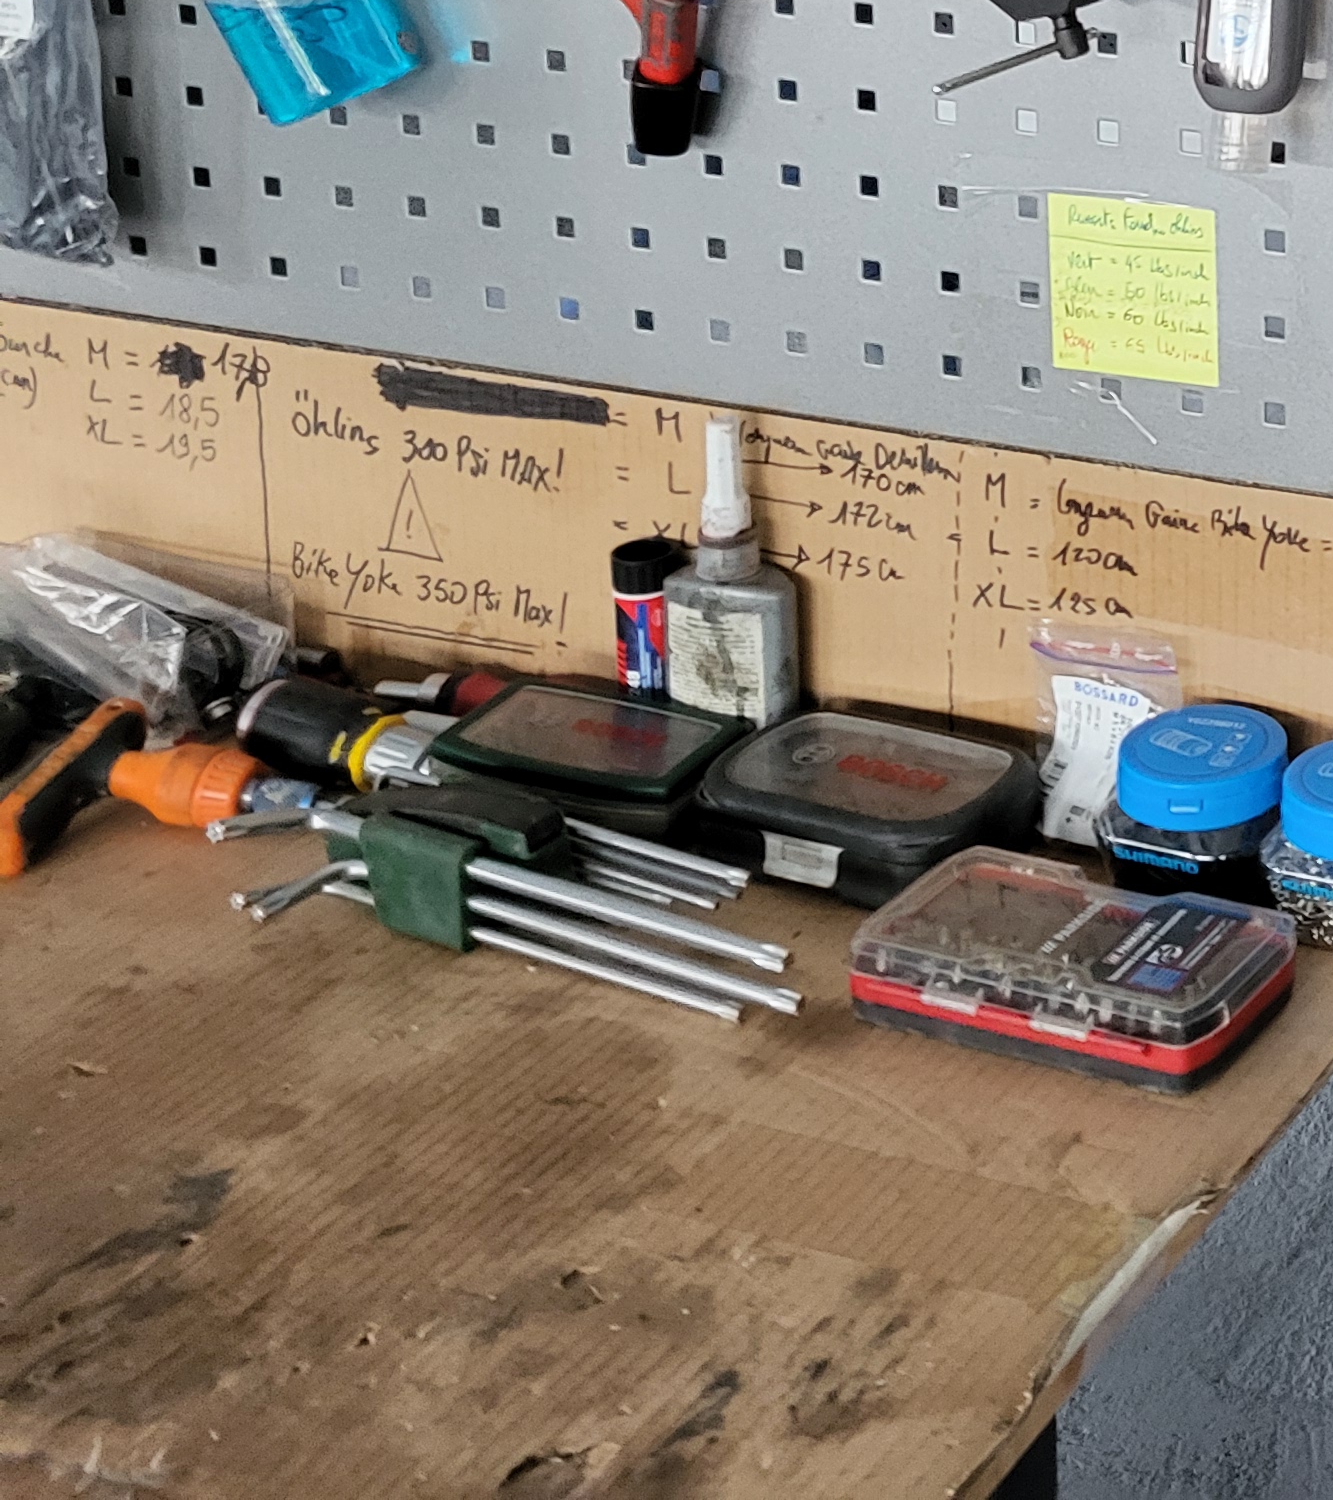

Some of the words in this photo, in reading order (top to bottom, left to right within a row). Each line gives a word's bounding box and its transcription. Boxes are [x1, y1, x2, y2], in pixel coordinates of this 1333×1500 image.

[87, 337, 110, 370] M
[89, 379, 112, 404] L
[159, 393, 220, 431] 18,5
[654, 407, 683, 443] M
[86, 414, 123, 446] XL
[156, 432, 217, 472] 19,5
[402, 429, 449, 463] 300
[668, 461, 692, 494] L
[984, 472, 1006, 508] M
[988, 530, 1009, 556] L
[415, 574, 468, 606] 350
[972, 582, 1024, 611] XL
[1074, 680, 1140, 708] BOSSARD
[836, 753, 949, 792] BOSCH
[1112, 844, 1199, 875] SHIMANO
